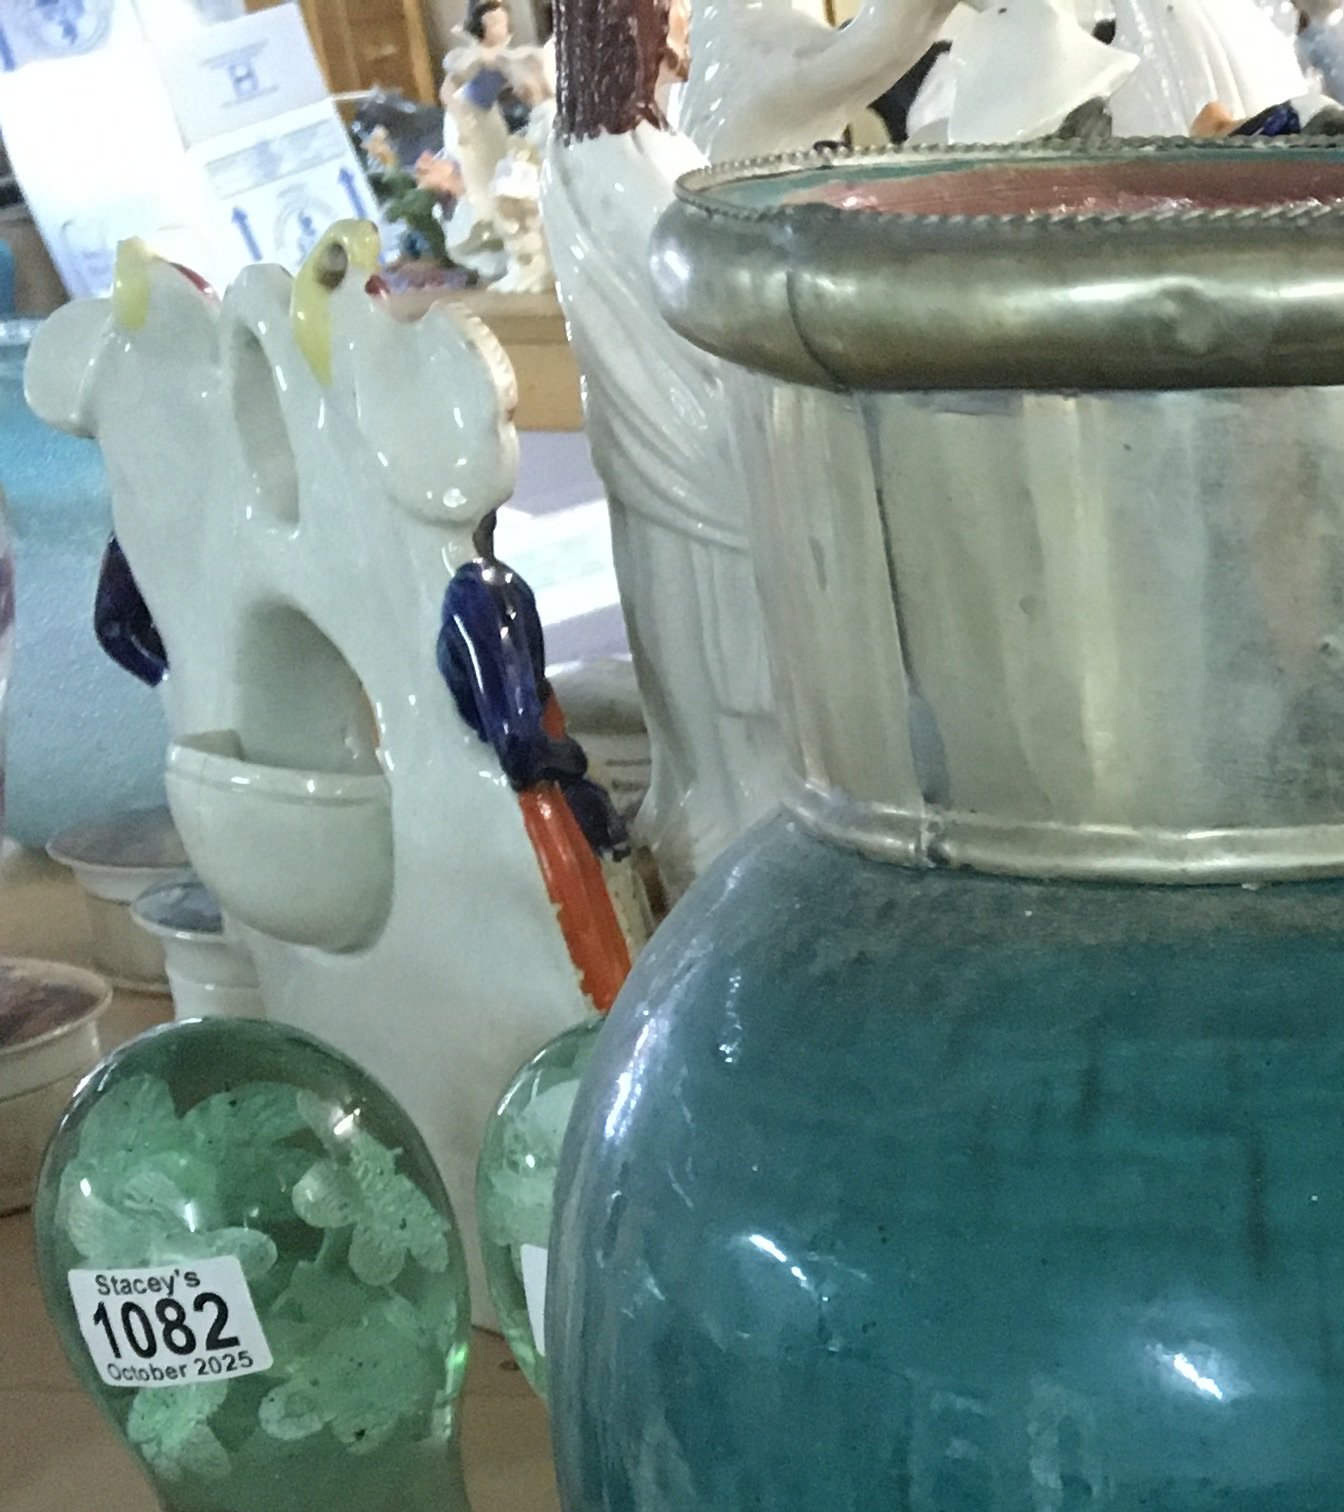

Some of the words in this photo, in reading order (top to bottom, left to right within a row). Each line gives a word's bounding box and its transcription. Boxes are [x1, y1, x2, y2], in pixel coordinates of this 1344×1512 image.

[95, 1269, 201, 1297] Stacey's
[93, 1292, 241, 1360] 1082
[107, 1362, 188, 1382] October
[193, 1350, 254, 1377] 2025
